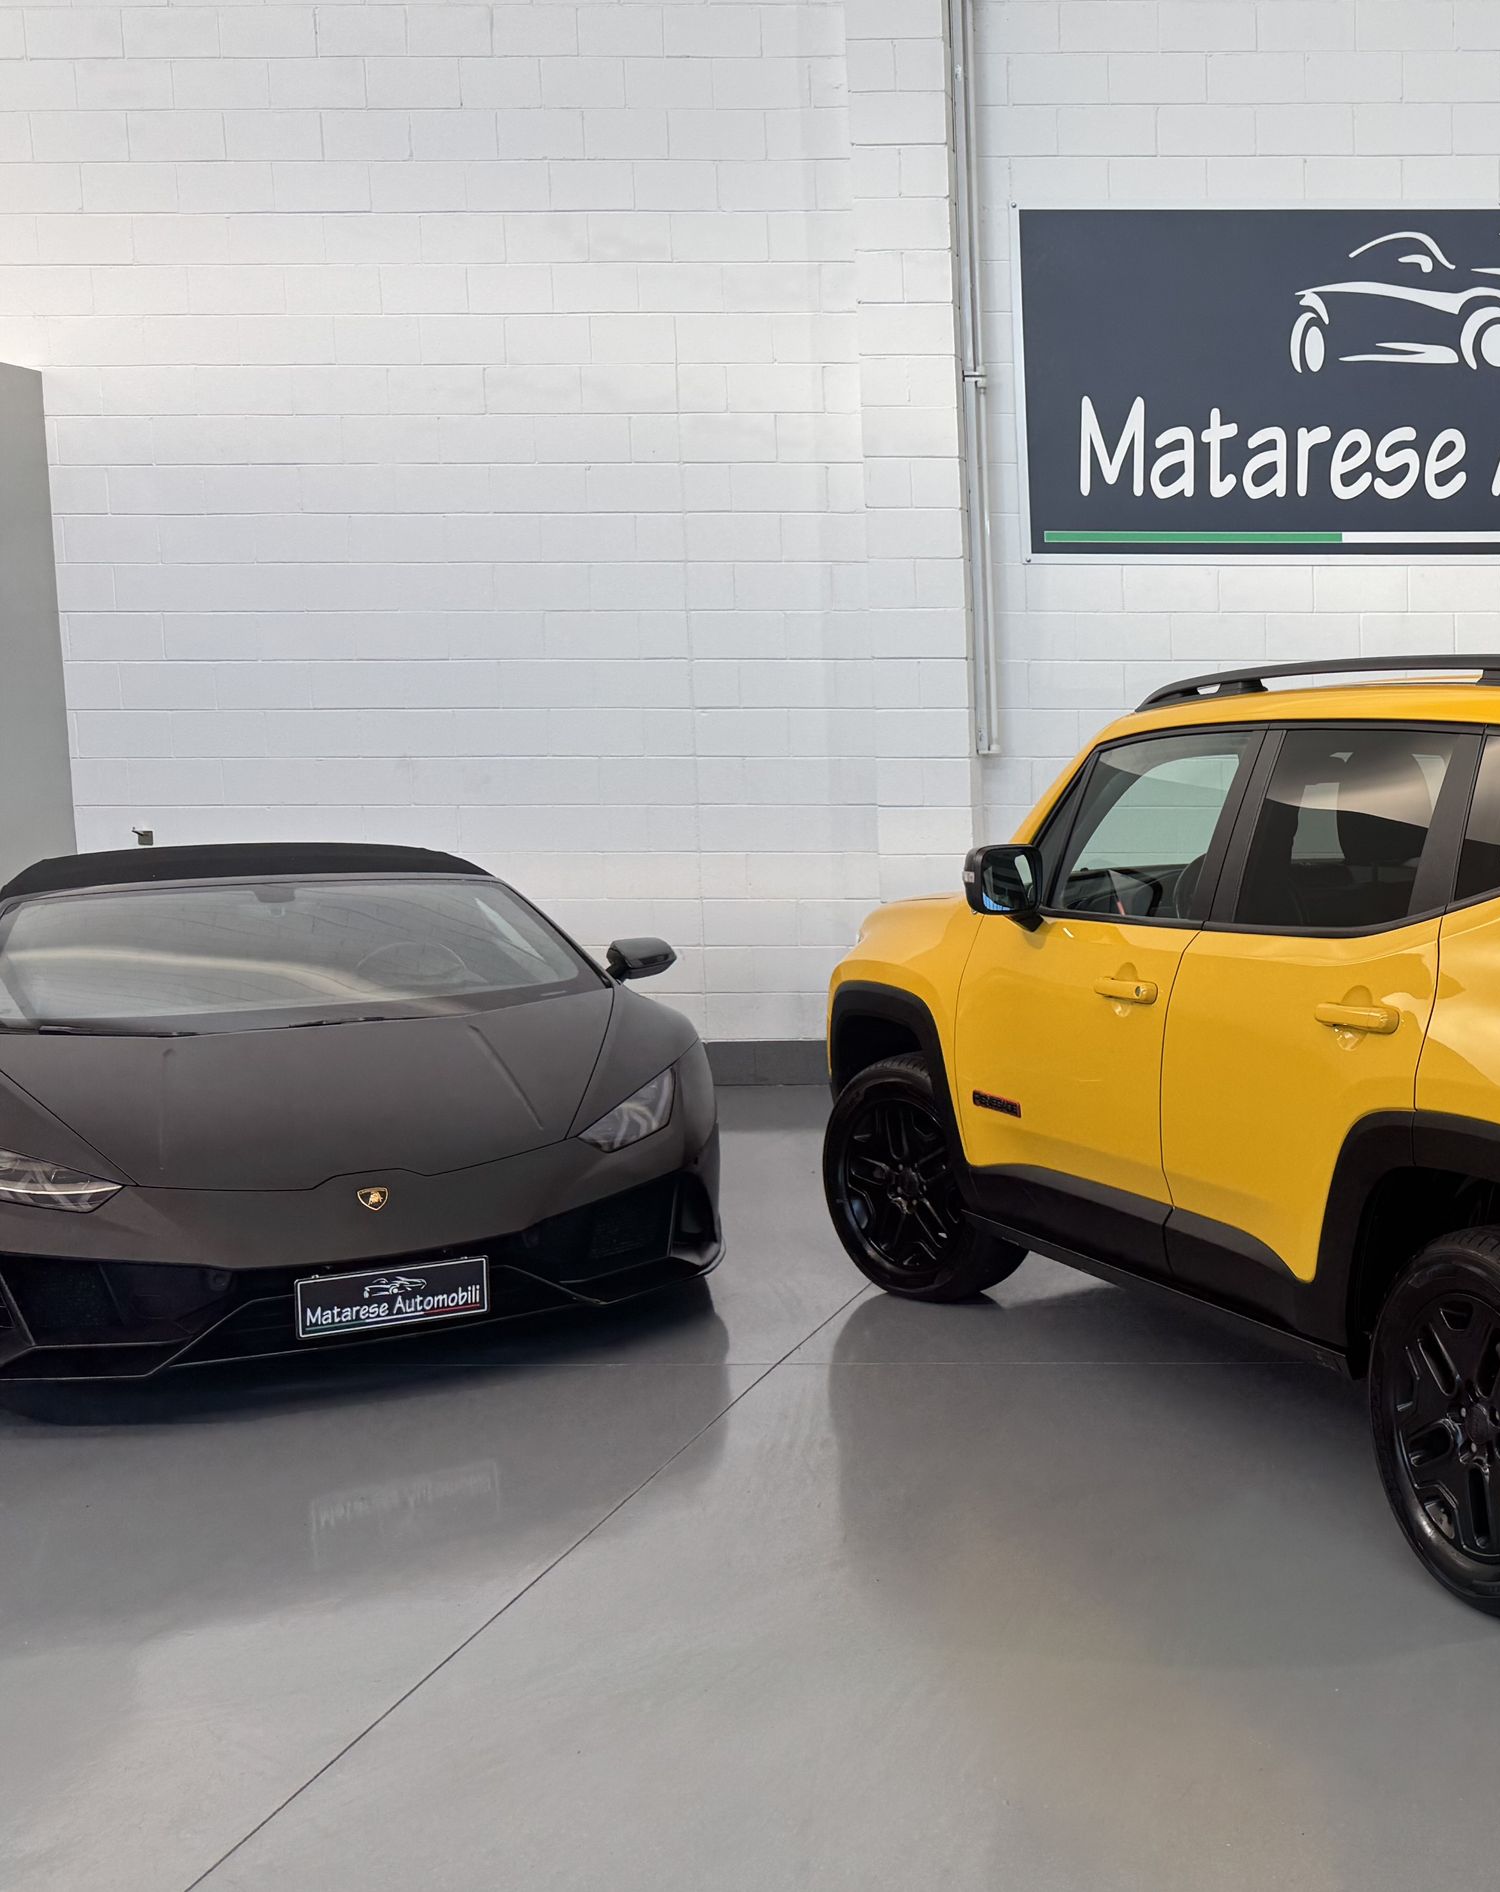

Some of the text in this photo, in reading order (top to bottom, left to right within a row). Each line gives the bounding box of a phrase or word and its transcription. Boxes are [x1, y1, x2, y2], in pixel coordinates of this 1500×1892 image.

[1079, 395, 1467, 500] Matarese
[306, 1284, 480, 1327] Matarese Automobili
